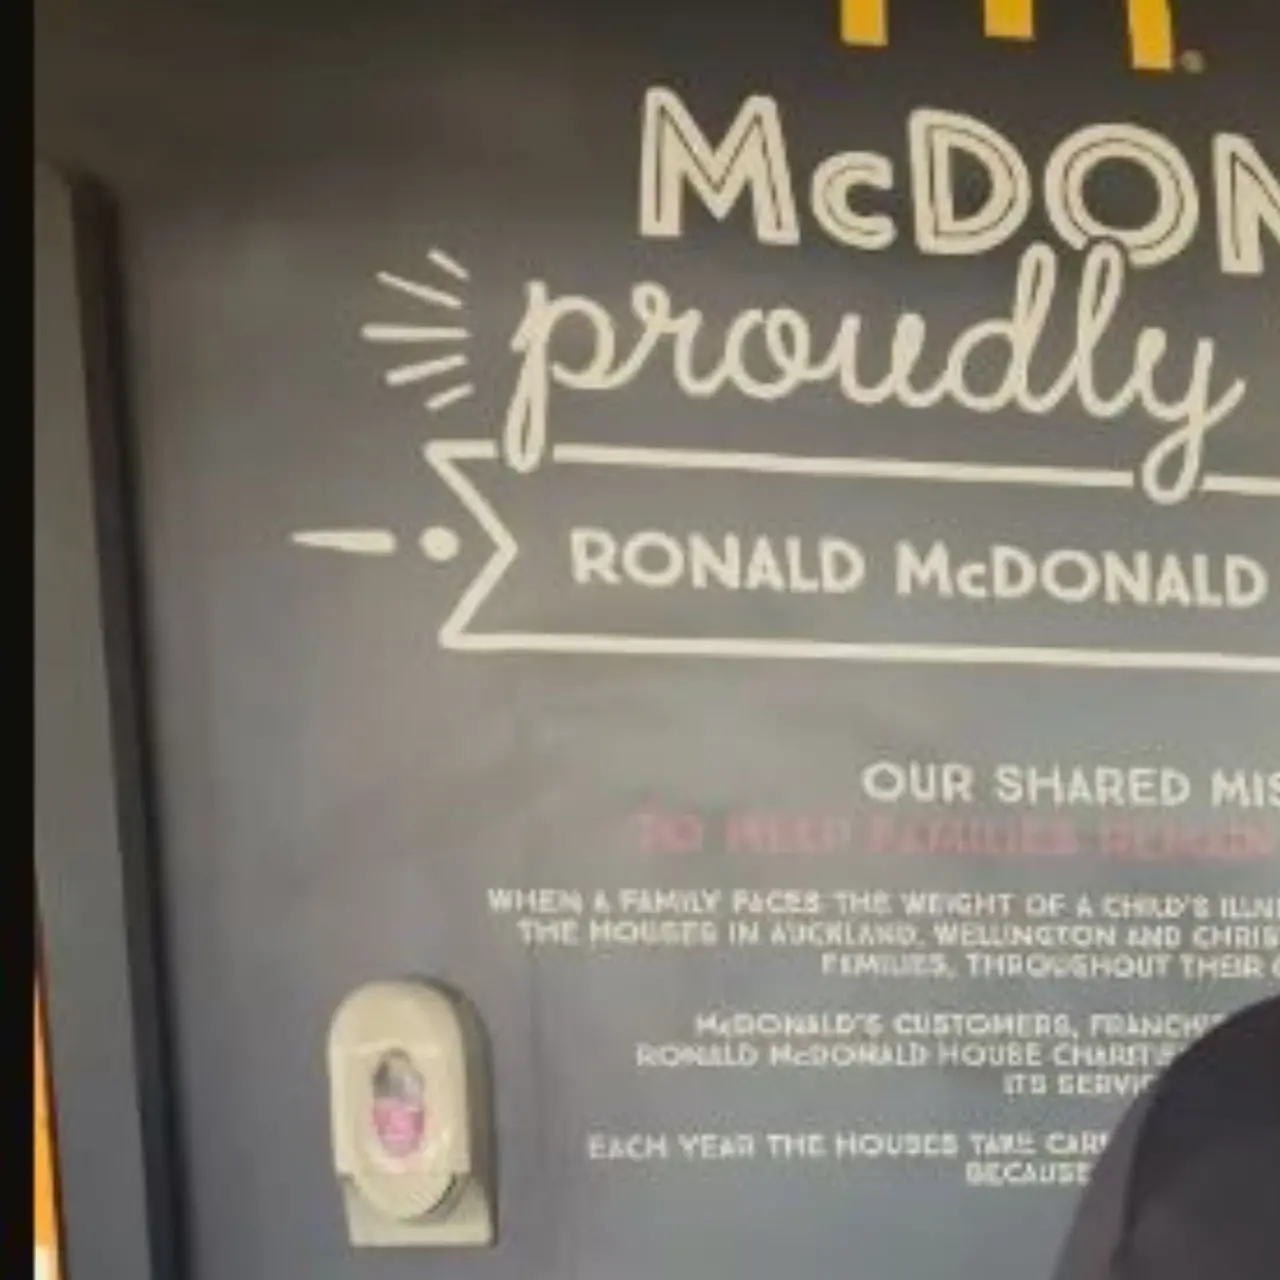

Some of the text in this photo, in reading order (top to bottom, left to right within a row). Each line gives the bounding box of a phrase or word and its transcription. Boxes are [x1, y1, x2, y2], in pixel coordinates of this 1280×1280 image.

[504, 238, 1247, 504] proudly
[571, 529, 867, 593] RONALD
[896, 540, 1264, 609] McDONALD
[861, 762, 974, 803] OUR
[993, 764, 1191, 808] SHARED
[487, 887, 583, 915] WHEN
[618, 888, 722, 916] FAMILY
[732, 889, 822, 916] FACES
[832, 890, 894, 916] THE
[903, 890, 1014, 918] WEIGHT
[1024, 892, 1066, 917] OF
[517, 919, 578, 946] THE
[590, 919, 718, 947] HOUSES
[729, 920, 759, 946] IN
[933, 921, 1116, 948] WELLINGTON
[1126, 923, 1181, 949] AND
[966, 953, 1170, 979] THROUGHOUT
[1181, 954, 1264, 979] THEIR
[696, 1012, 881, 1036] McDONALD'S
[637, 1043, 758, 1069] RONALD
[770, 1043, 928, 1068] McDONALD
[938, 1042, 1043, 1068] HOUSE
[588, 1133, 668, 1160] EACH
[679, 1132, 756, 1159] YEAR
[766, 1132, 826, 1158] THE
[834, 1132, 958, 1158] HOUSES
